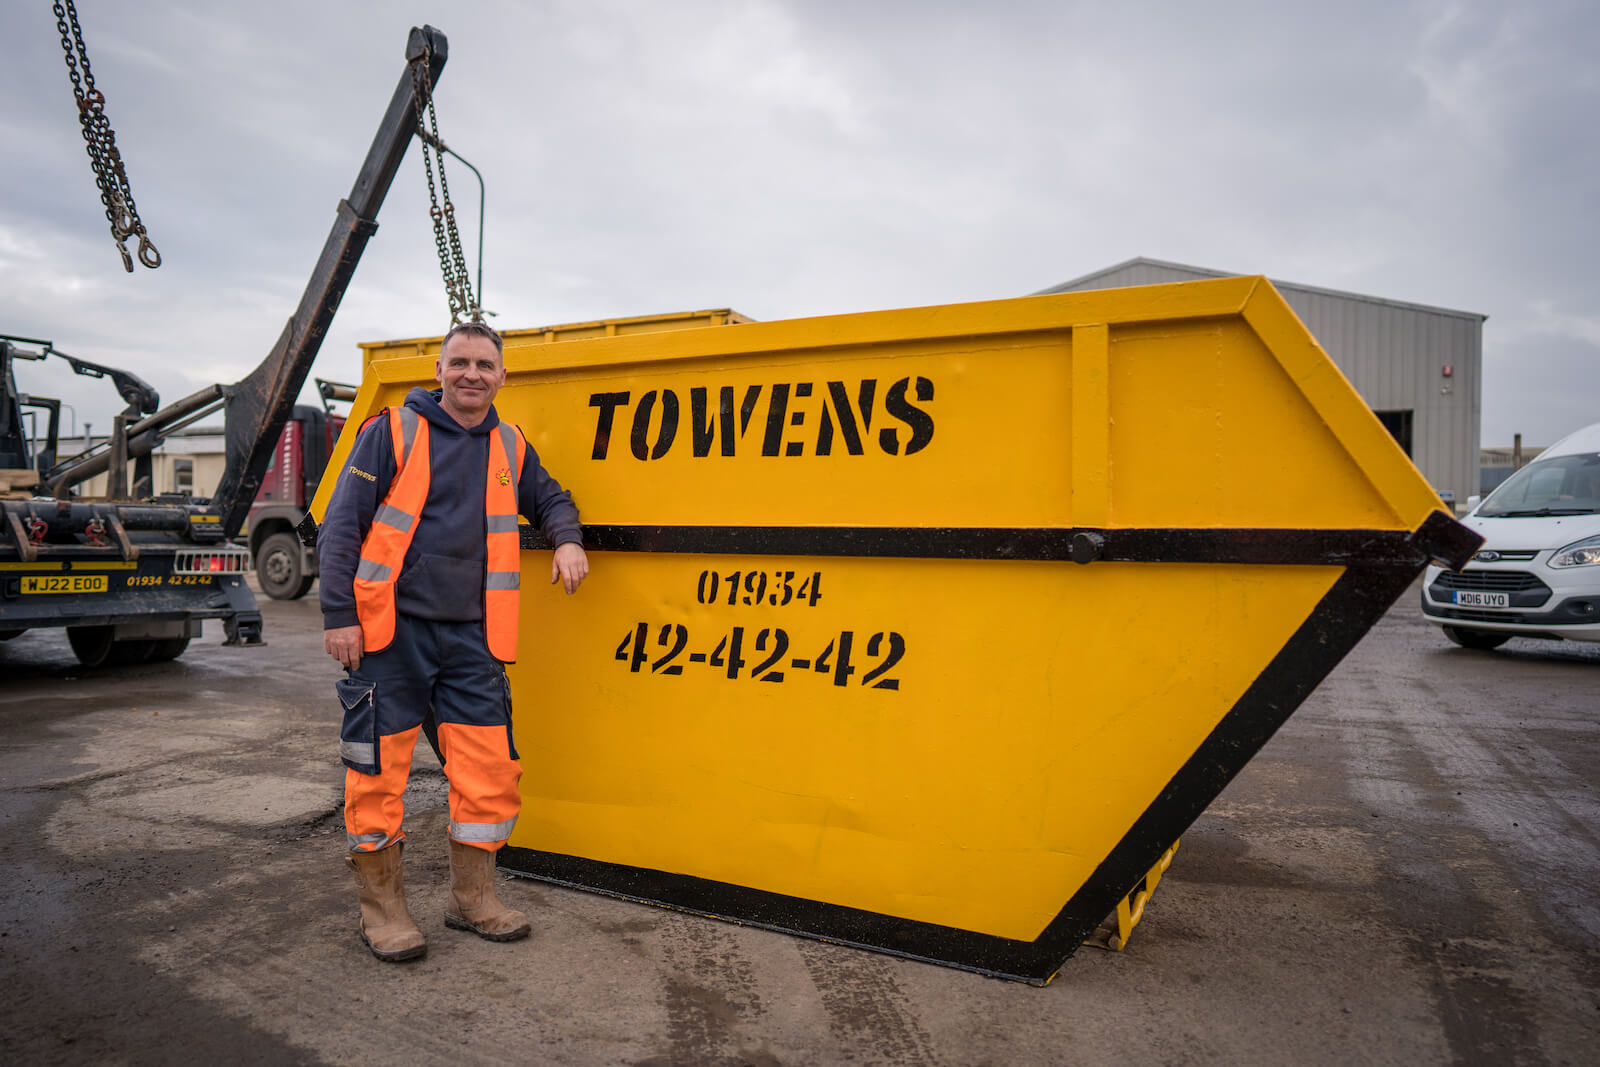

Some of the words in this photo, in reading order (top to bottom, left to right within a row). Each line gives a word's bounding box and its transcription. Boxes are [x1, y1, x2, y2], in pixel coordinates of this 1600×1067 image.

[589, 376, 935, 461] TOWENS
[28, 578, 70, 592] WJ22
[127, 576, 162, 586] 01934
[697, 570, 822, 607] 01934
[615, 622, 906, 690] 42-42-42
